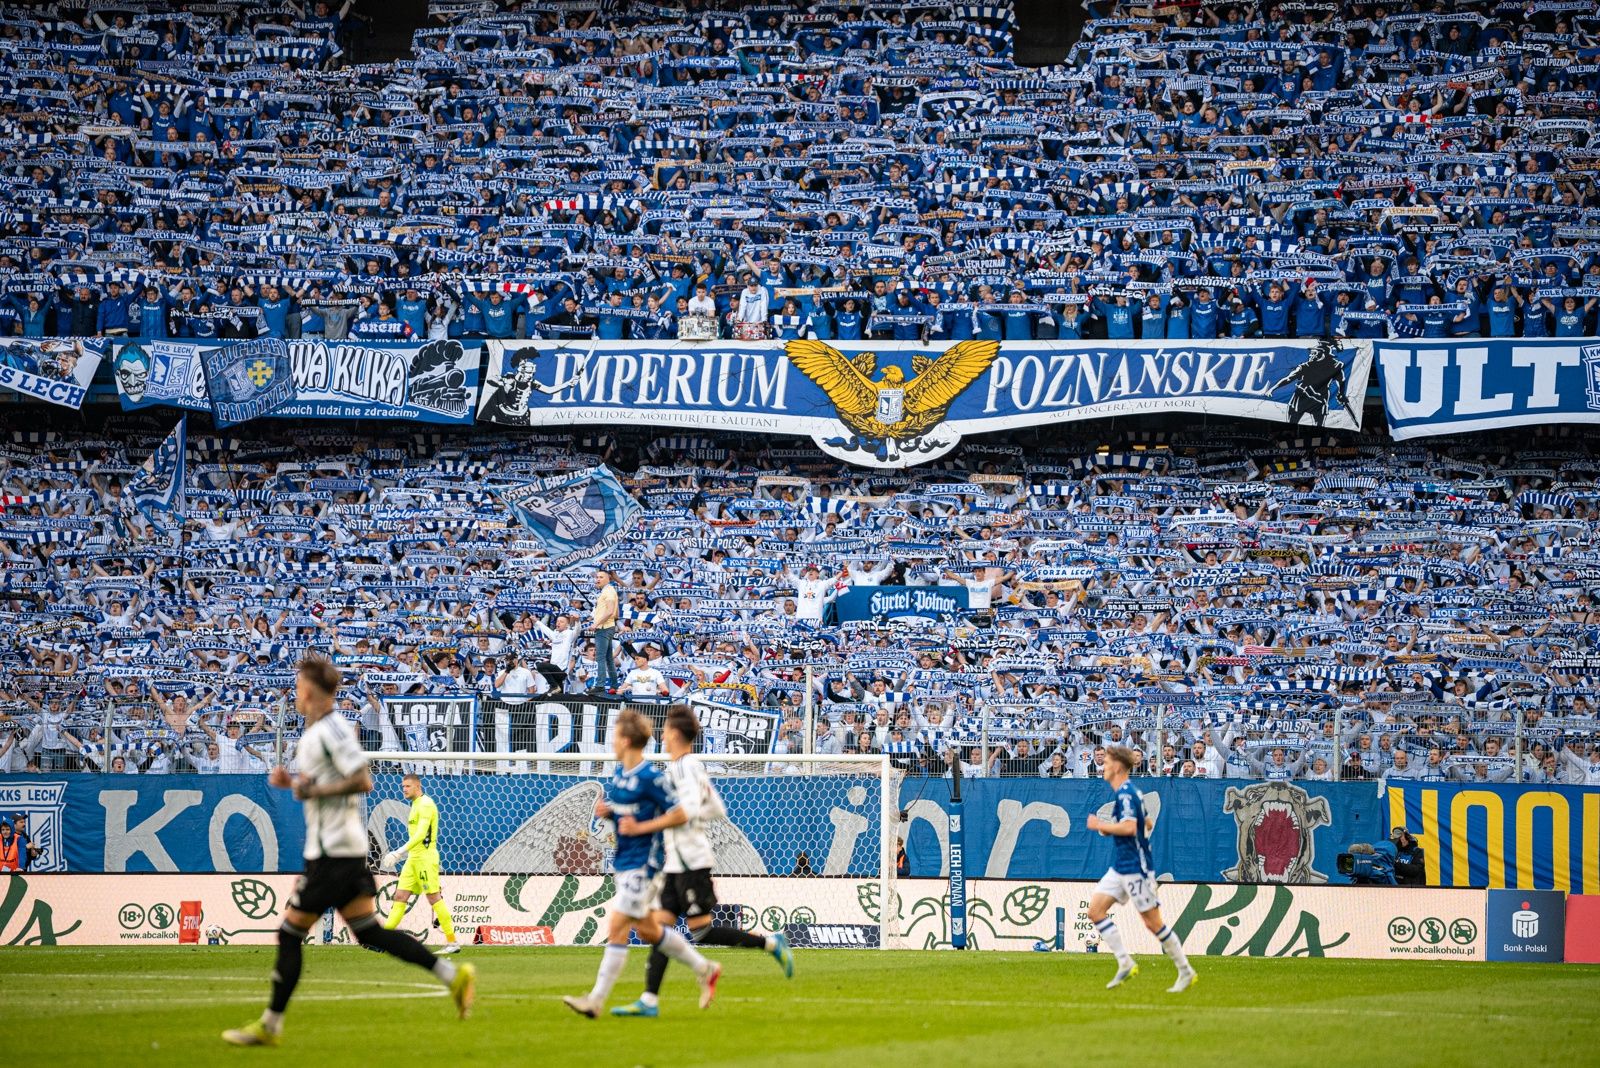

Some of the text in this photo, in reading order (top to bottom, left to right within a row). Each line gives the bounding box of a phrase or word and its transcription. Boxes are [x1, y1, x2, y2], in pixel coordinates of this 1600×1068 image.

[156, 344, 193, 354] KKS LECH
[332, 346, 407, 407] KLIKA
[552, 346, 1276, 414] IMPERIUM POZNAŃSKIE
[1380, 347, 1582, 418] ULT
[17, 375, 87, 409] LECH
[277, 404, 313, 416] swoich
[316, 404, 342, 416] ludzi
[345, 406, 360, 416] nie
[363, 406, 419, 418] zdradzimy
[1135, 401, 1158, 410] AUT
[1161, 400, 1198, 410] MORI
[553, 410, 574, 420] AVE
[637, 412, 701, 424] MORITURI
[703, 414, 717, 424] TE
[720, 416, 781, 428] SALUTANT
[524, 498, 542, 512] FC
[394, 704, 462, 726] LOLA
[28, 788, 57, 802] LECH
[419, 870, 428, 881] 41
[952, 844, 964, 907] LECH POZNAŃ
[1128, 880, 1143, 896] 27
[456, 893, 488, 902] Dumny
[122, 910, 142, 922] 18+
[453, 905, 490, 914] sponsor
[472, 914, 492, 923] Lech
[1074, 922, 1093, 930] KKS
[1391, 924, 1412, 936] 18+
[490, 930, 546, 944] SUPERBET
[1390, 944, 1476, 956] www.abcalkoholu.pl
[1504, 944, 1548, 954] Bank Polski
